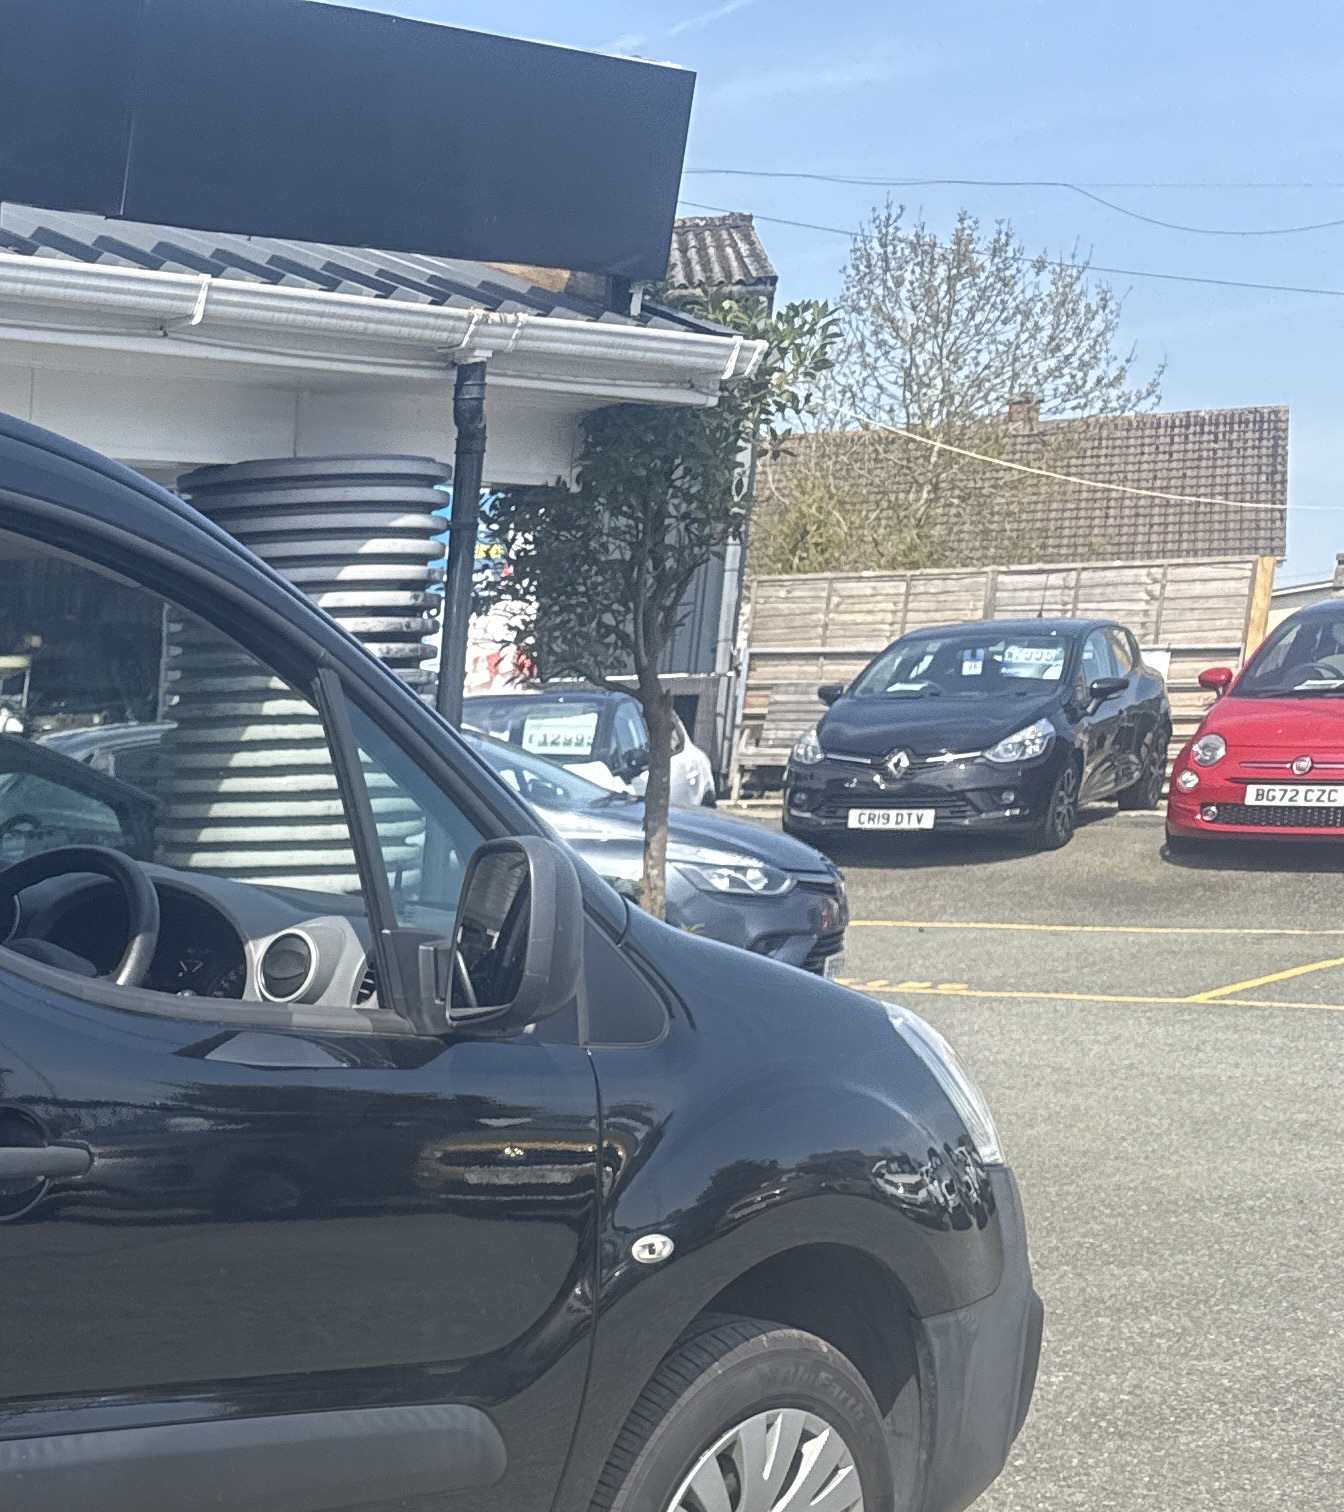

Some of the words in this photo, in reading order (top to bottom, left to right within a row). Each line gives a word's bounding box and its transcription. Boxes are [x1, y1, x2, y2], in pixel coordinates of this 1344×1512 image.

[1255, 788, 1300, 802] BG72
[1304, 788, 1339, 803] CZC
[858, 812, 891, 825] CR19
[895, 812, 924, 825] DTV
